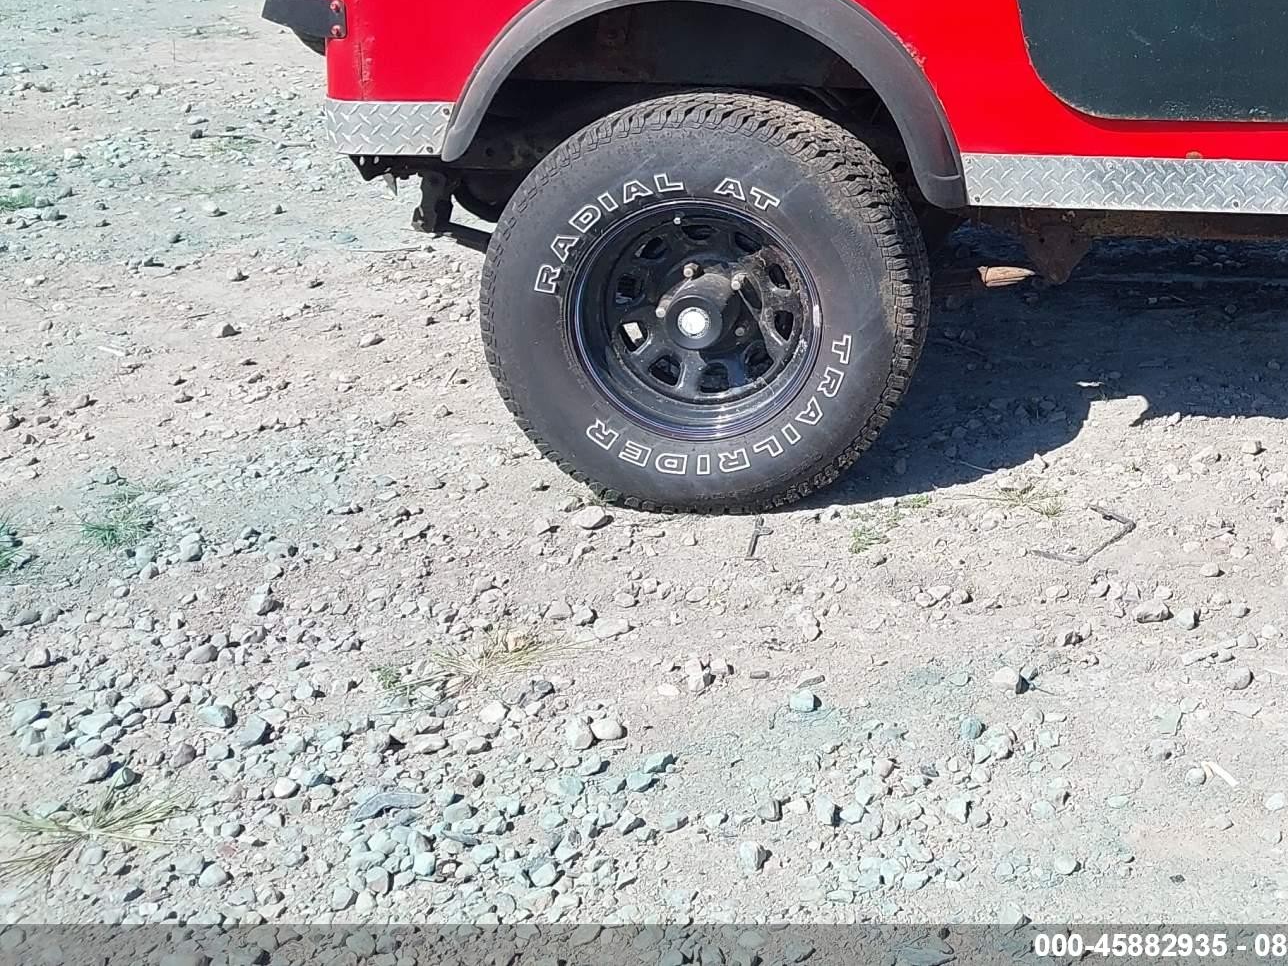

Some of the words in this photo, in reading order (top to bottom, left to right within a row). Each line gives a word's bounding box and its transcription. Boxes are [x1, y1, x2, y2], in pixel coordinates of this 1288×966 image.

[534, 173, 684, 295] RADIAL
[714, 177, 780, 211] AT
[586, 335, 852, 475] TRAILRIDER
